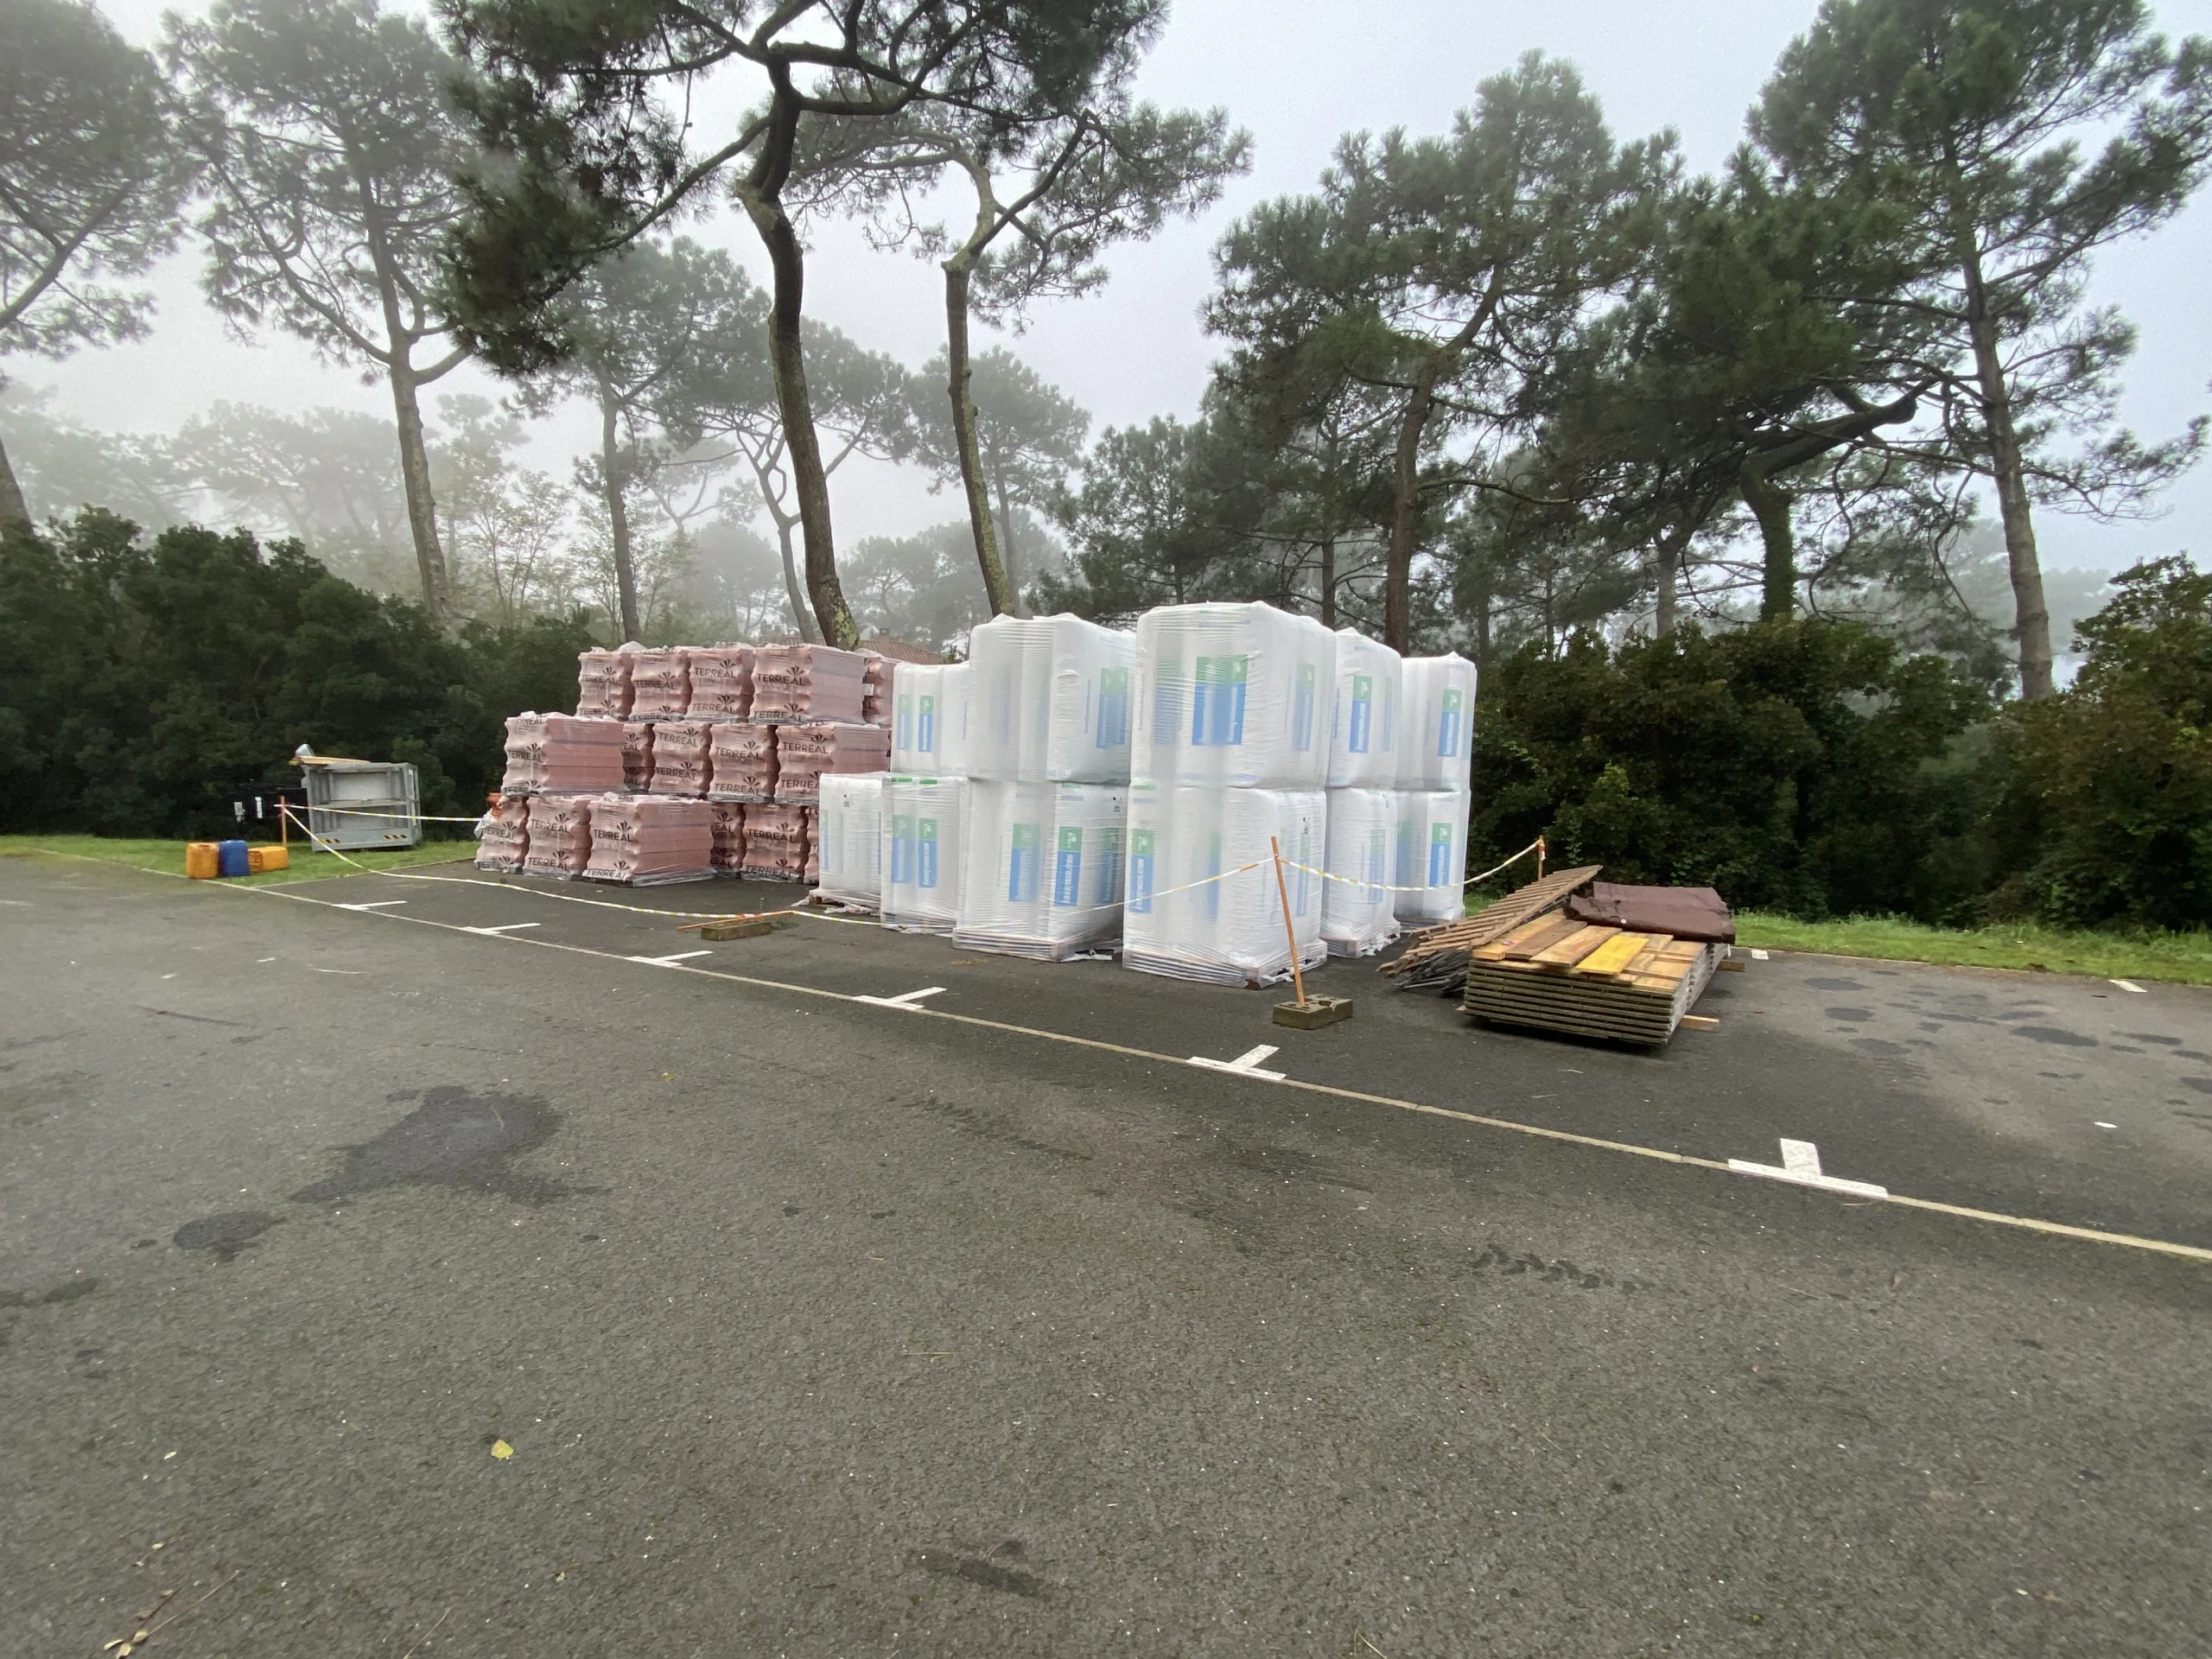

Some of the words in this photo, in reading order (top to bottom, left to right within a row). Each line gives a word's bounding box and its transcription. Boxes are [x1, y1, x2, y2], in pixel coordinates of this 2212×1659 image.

[695, 667, 737, 678] TERREAL
[634, 680, 677, 690] TERREAL
[757, 674, 805, 686] TERREAL
[693, 702, 734, 714] TERREAL
[658, 732, 698, 747] TERREAL
[783, 741, 829, 753] TERREAL
[508, 749, 543, 763] TERREAL
[715, 747, 764, 761] TERREAL
[656, 766, 697, 781] TERREAL
[781, 779, 819, 789] TERREA
[531, 818, 570, 833] TERREAL
[594, 829, 633, 842] TERREAL
[748, 828, 797, 843] TERREAL
[528, 857, 569, 871] TERREAL
